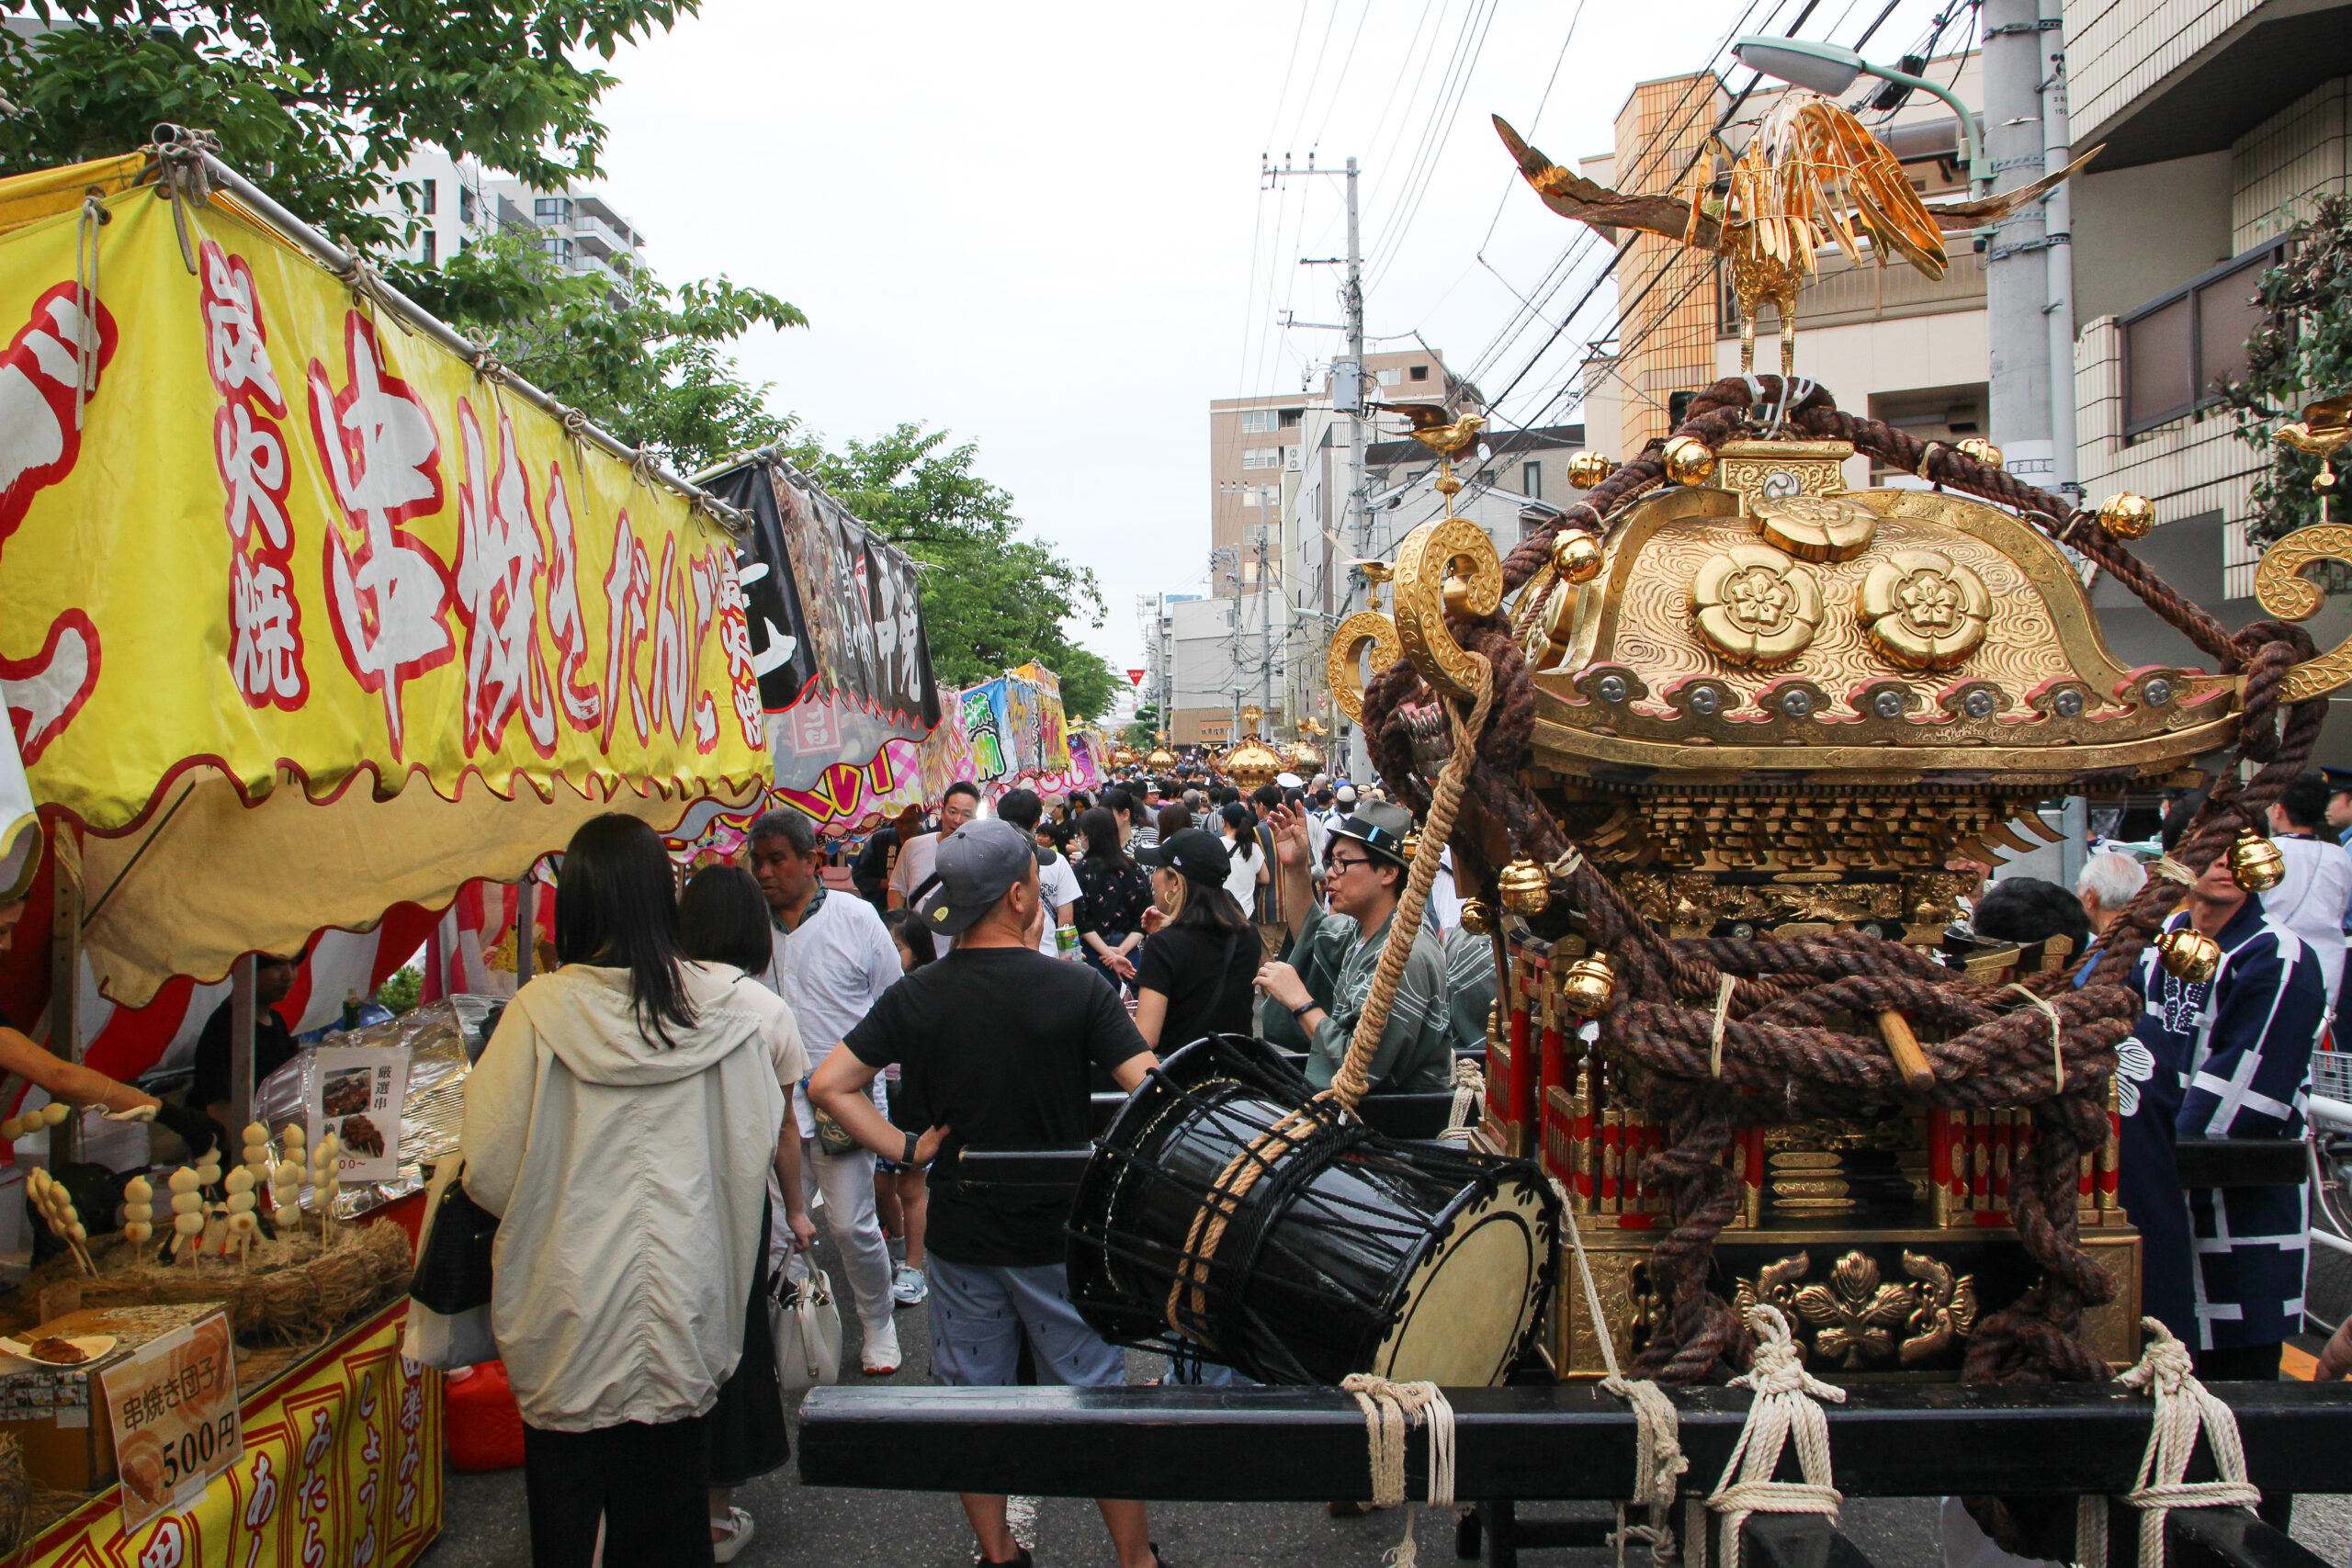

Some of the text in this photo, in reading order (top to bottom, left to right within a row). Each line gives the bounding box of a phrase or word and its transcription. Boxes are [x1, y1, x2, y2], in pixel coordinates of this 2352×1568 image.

[199, 240, 307, 711] 炭火焼
[309, 310, 728, 764] 串焼きだんご
[373, 1065, 392, 1111] 厳選串
[122, 1356, 217, 1431] 串焼き団子
[163, 1410, 235, 1489] 500円
